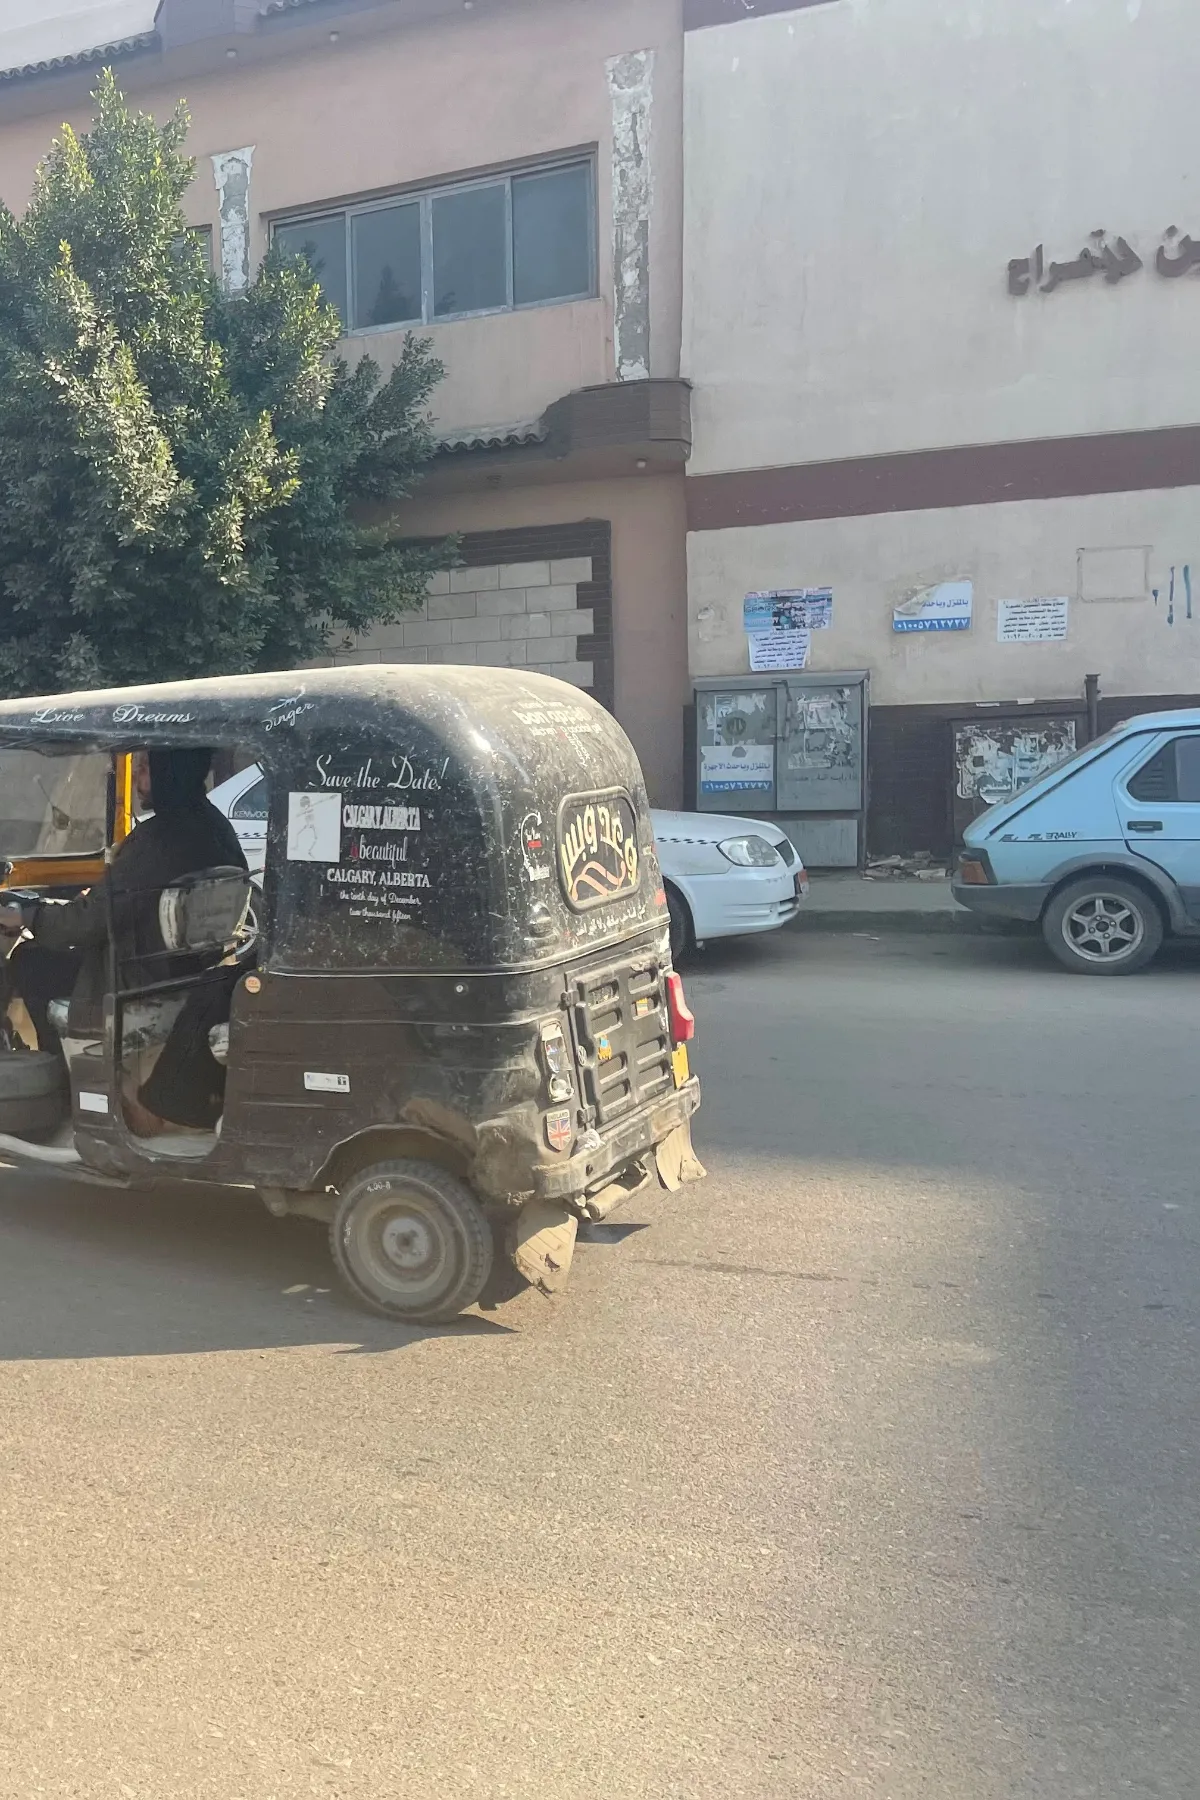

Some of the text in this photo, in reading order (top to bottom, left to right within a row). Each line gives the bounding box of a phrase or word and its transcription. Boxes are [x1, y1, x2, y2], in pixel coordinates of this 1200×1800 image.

[112, 703, 196, 724] Dreams
[309, 753, 450, 791] Save the Date!
[360, 834, 408, 870] beautiful
[326, 868, 432, 888] CALGARY, ALBERTA
